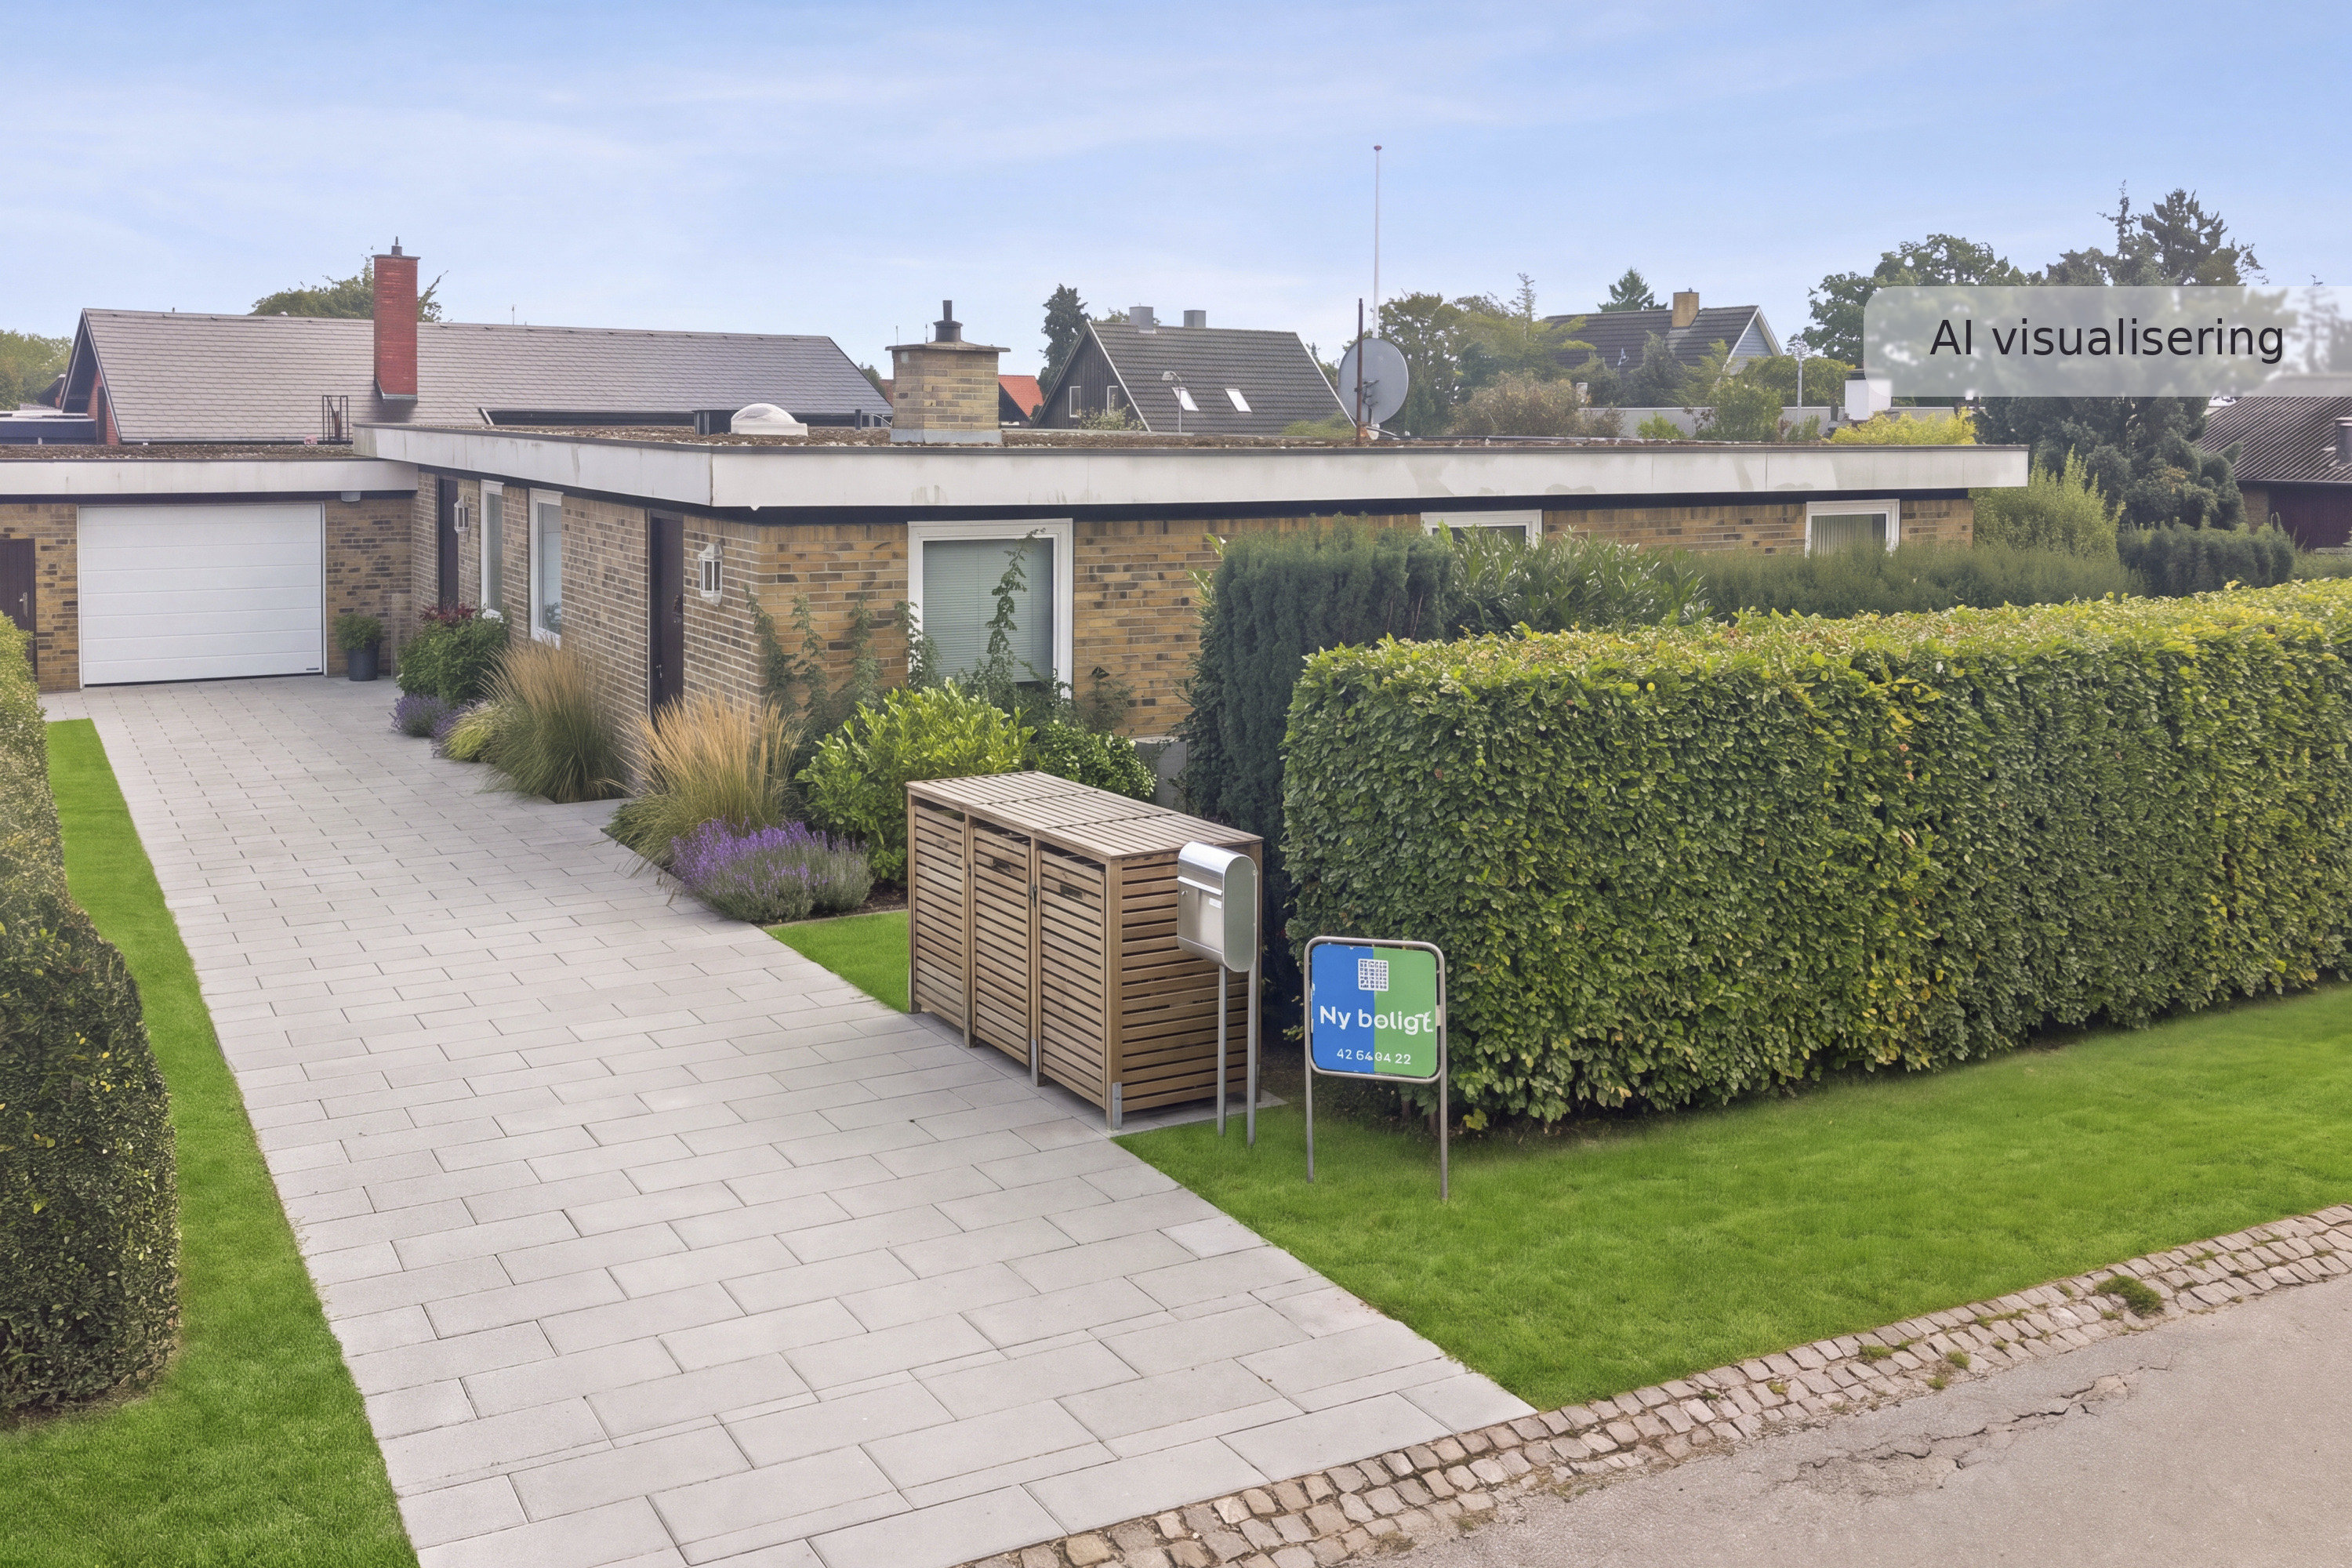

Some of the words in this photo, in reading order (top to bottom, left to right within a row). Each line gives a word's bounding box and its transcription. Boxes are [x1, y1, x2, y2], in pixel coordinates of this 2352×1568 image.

[1319, 1005, 1351, 1030] Ny
[1337, 1048, 1352, 1060] 42
[1396, 1053, 1411, 1065] 22
